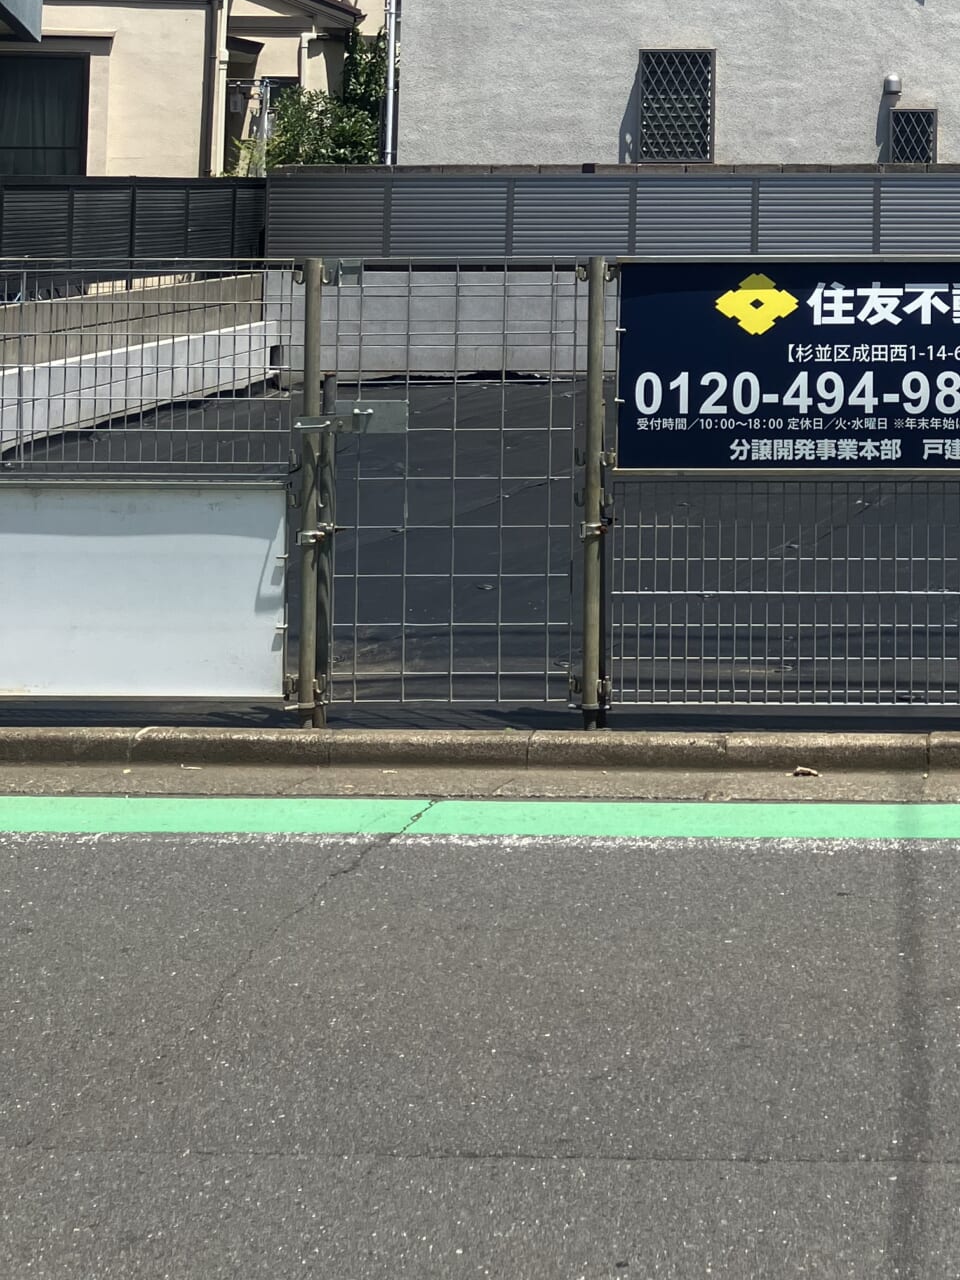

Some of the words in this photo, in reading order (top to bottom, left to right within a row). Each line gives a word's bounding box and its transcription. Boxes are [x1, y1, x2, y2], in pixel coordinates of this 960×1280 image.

[729, 438, 902, 461] 分譲開発事業本部
